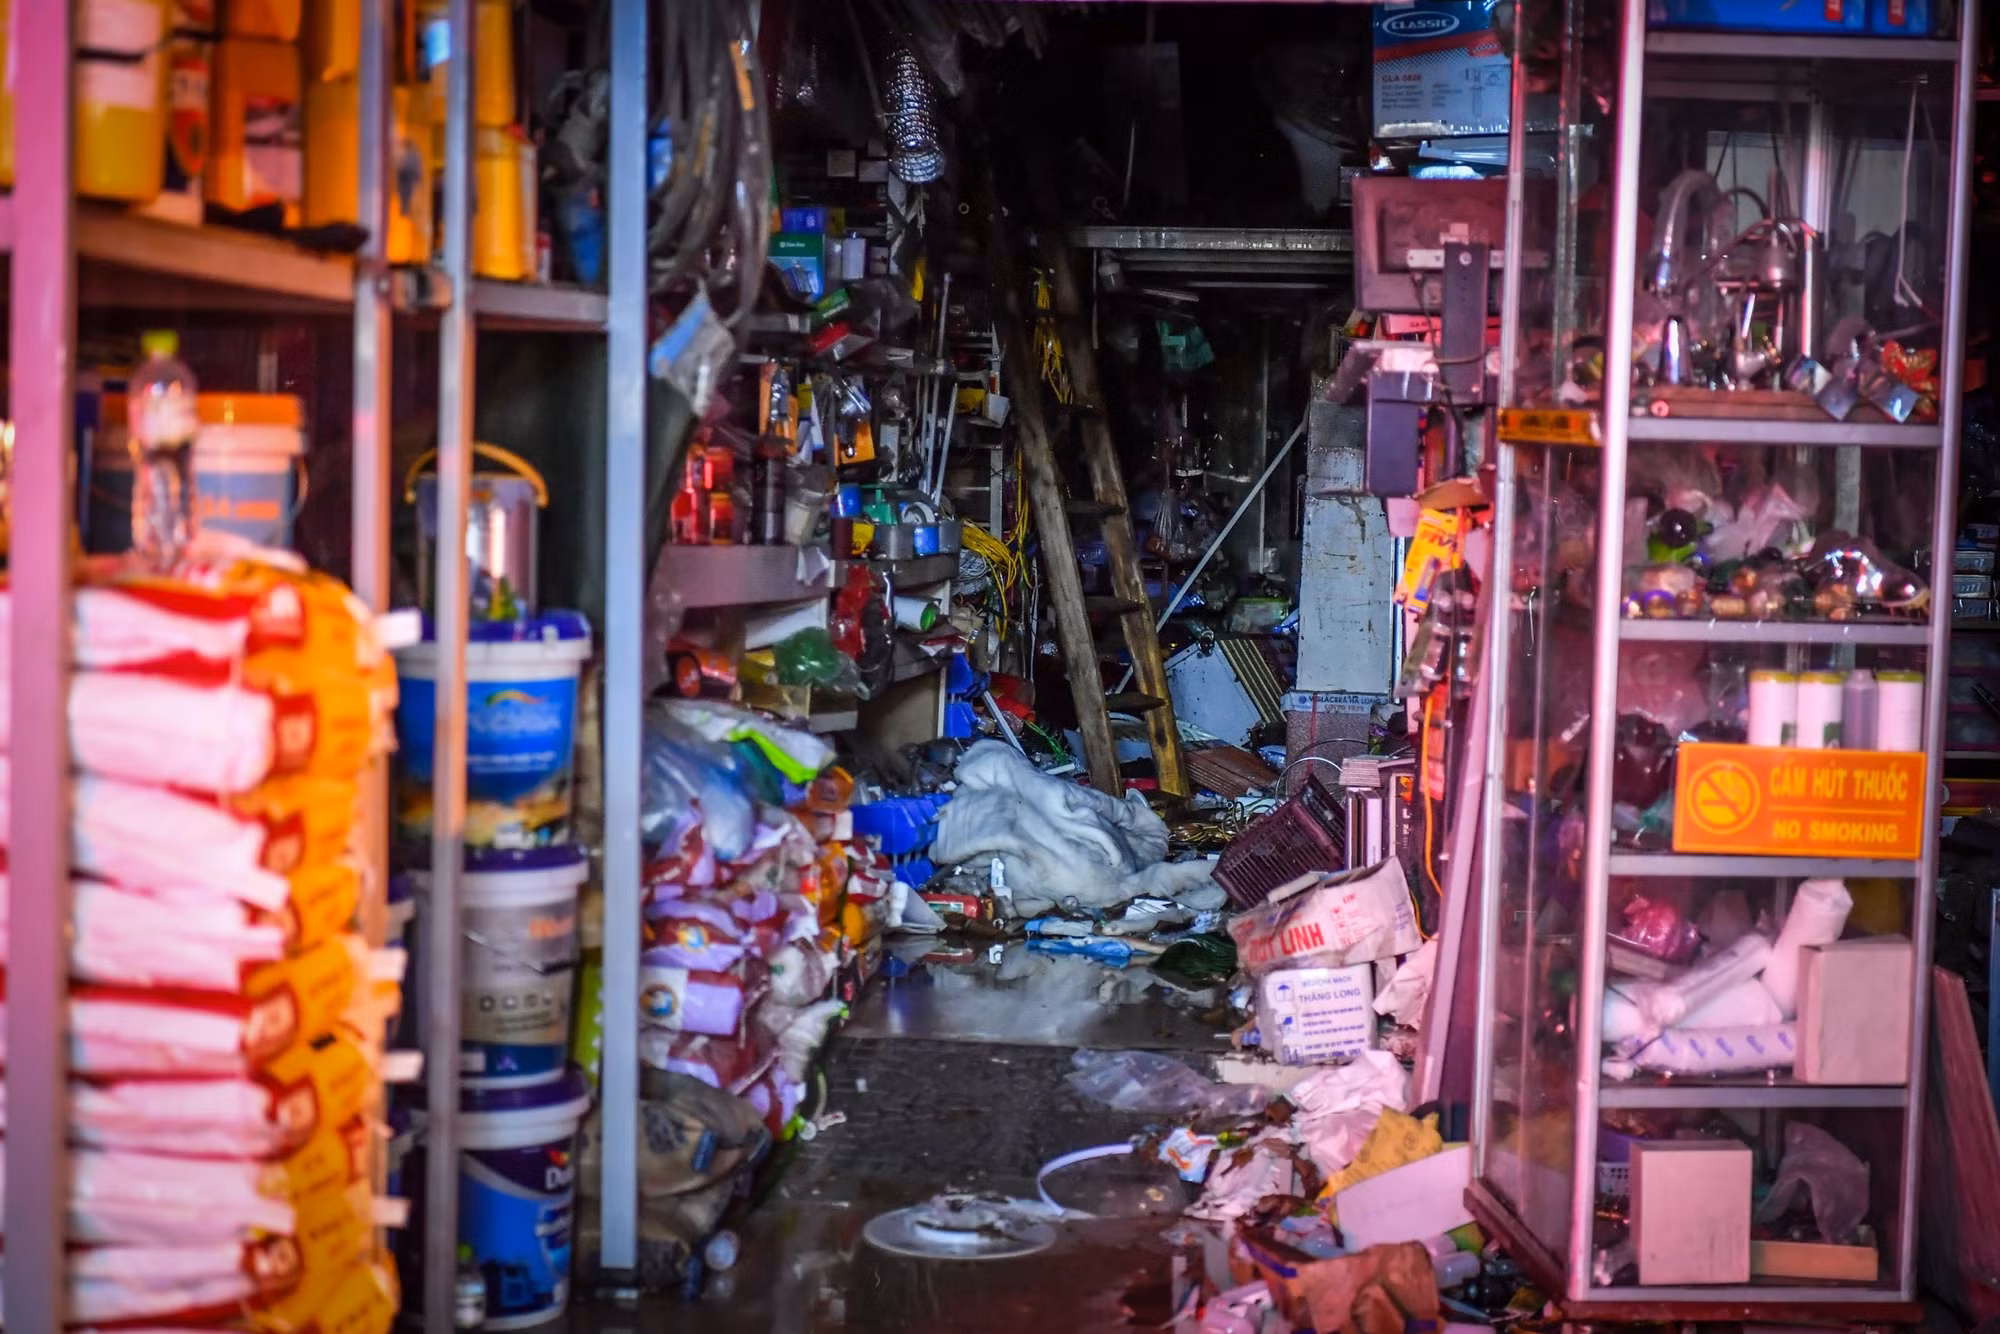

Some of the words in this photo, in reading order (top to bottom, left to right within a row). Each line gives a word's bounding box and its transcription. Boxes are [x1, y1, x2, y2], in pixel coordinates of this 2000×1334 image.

[1391, 20, 1449, 30] CLASSIC
[1309, 695, 1348, 704] VGLACERA
[1773, 819, 1800, 839] NO
[1808, 820, 1898, 843] SMOKING
[1279, 922, 1325, 955] LINH
[1334, 987, 1361, 999] LONG
